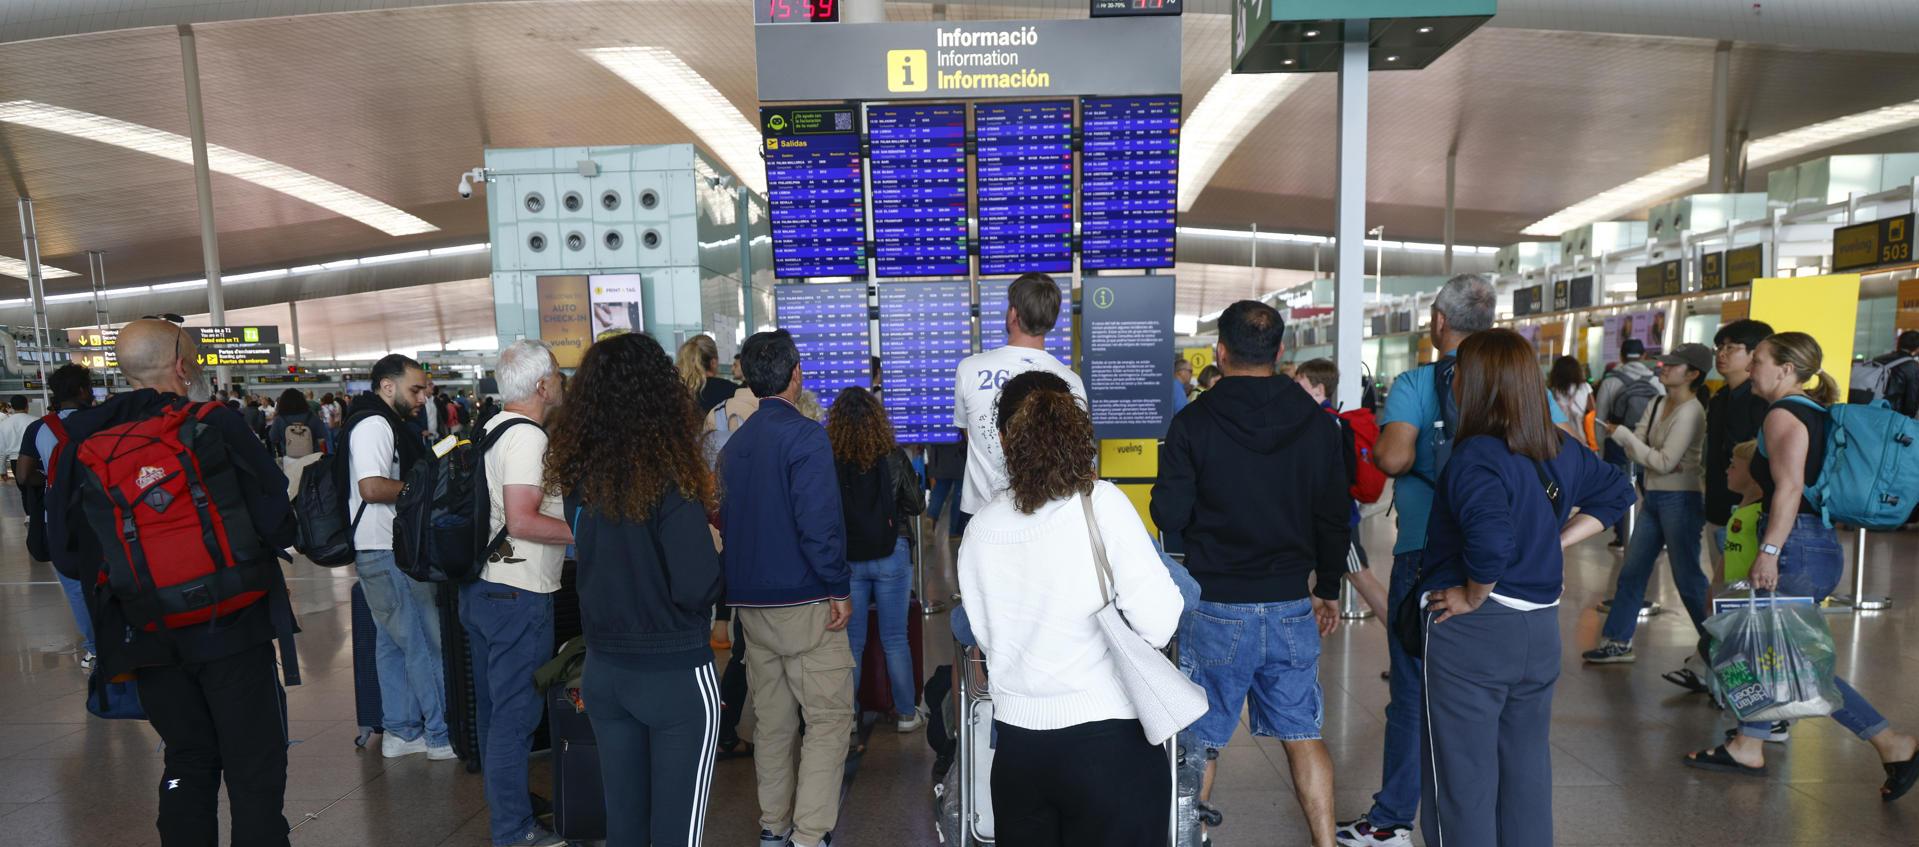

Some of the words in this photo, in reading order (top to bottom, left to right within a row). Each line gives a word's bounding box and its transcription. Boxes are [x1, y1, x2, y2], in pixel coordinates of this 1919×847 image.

[937, 28, 1038, 46] Informació
[938, 50, 1018, 66] Information
[938, 69, 1049, 88] Información
[1883, 243, 1908, 262] 503
[553, 304, 576, 312] AUTO
[544, 314, 586, 323] CHECK-IN
[550, 337, 581, 348] vueling
[1117, 442, 1142, 455] vueling
[1728, 683, 1762, 701] Coben
[1736, 690, 1769, 709] Harlan
